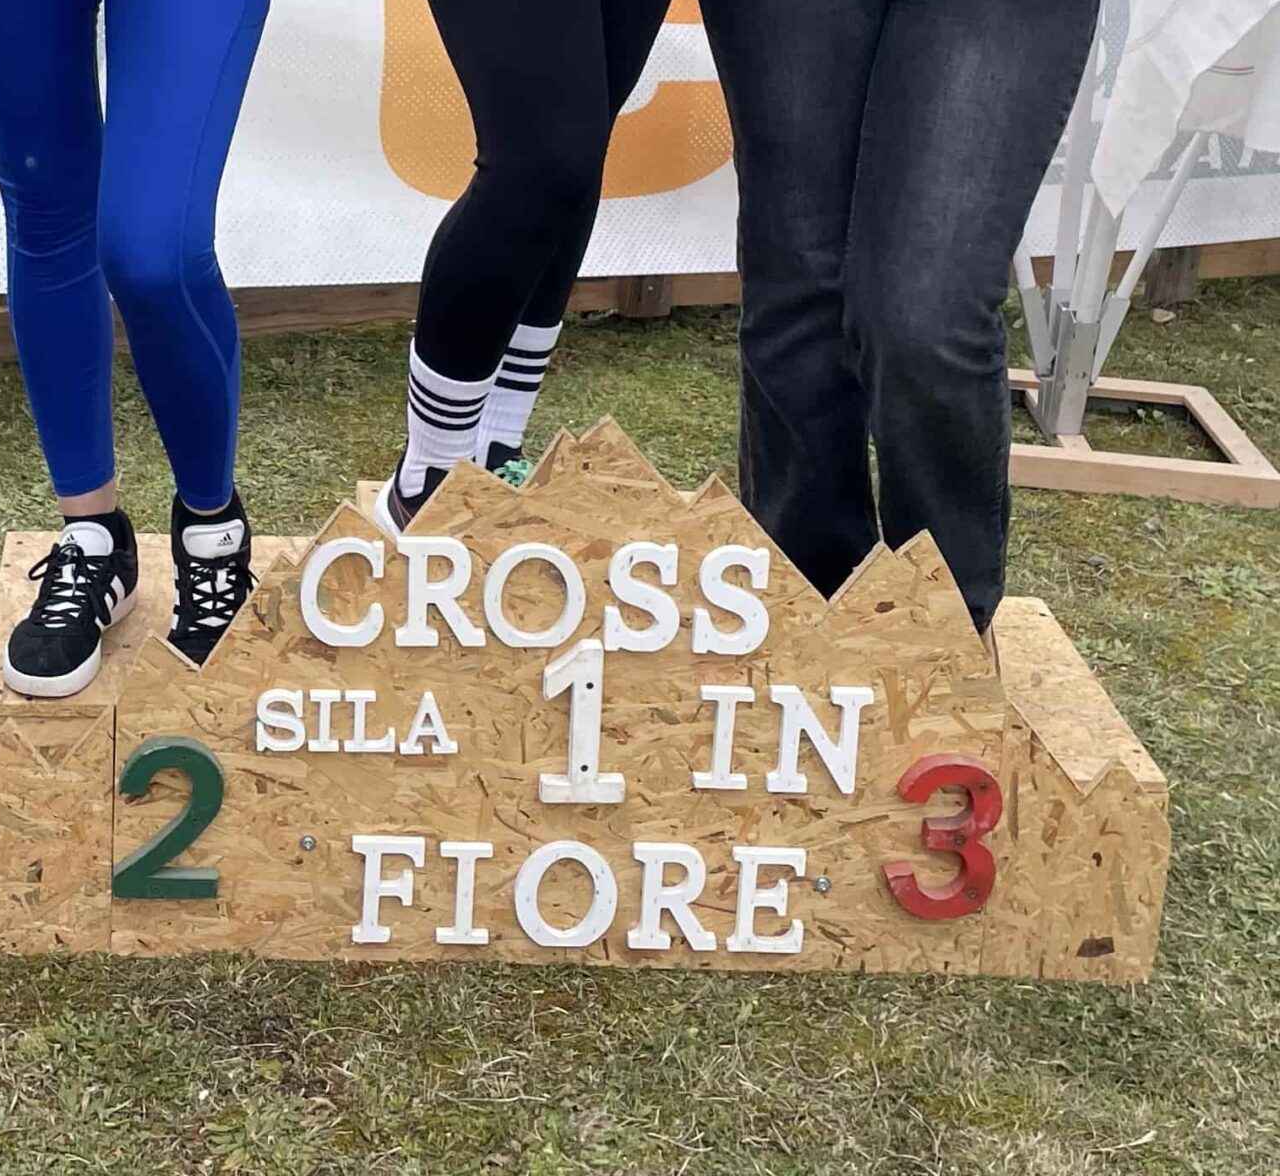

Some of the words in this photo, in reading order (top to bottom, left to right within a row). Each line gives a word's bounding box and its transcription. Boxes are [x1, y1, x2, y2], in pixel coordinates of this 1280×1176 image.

[302, 535, 770, 655] CROSS
[254, 687, 458, 756] SILA
[691, 682, 876, 796] IN
[536, 637, 627, 804] 1
[114, 735, 225, 902] 2
[883, 753, 1004, 919] 3
[351, 834, 807, 954] FIORE
